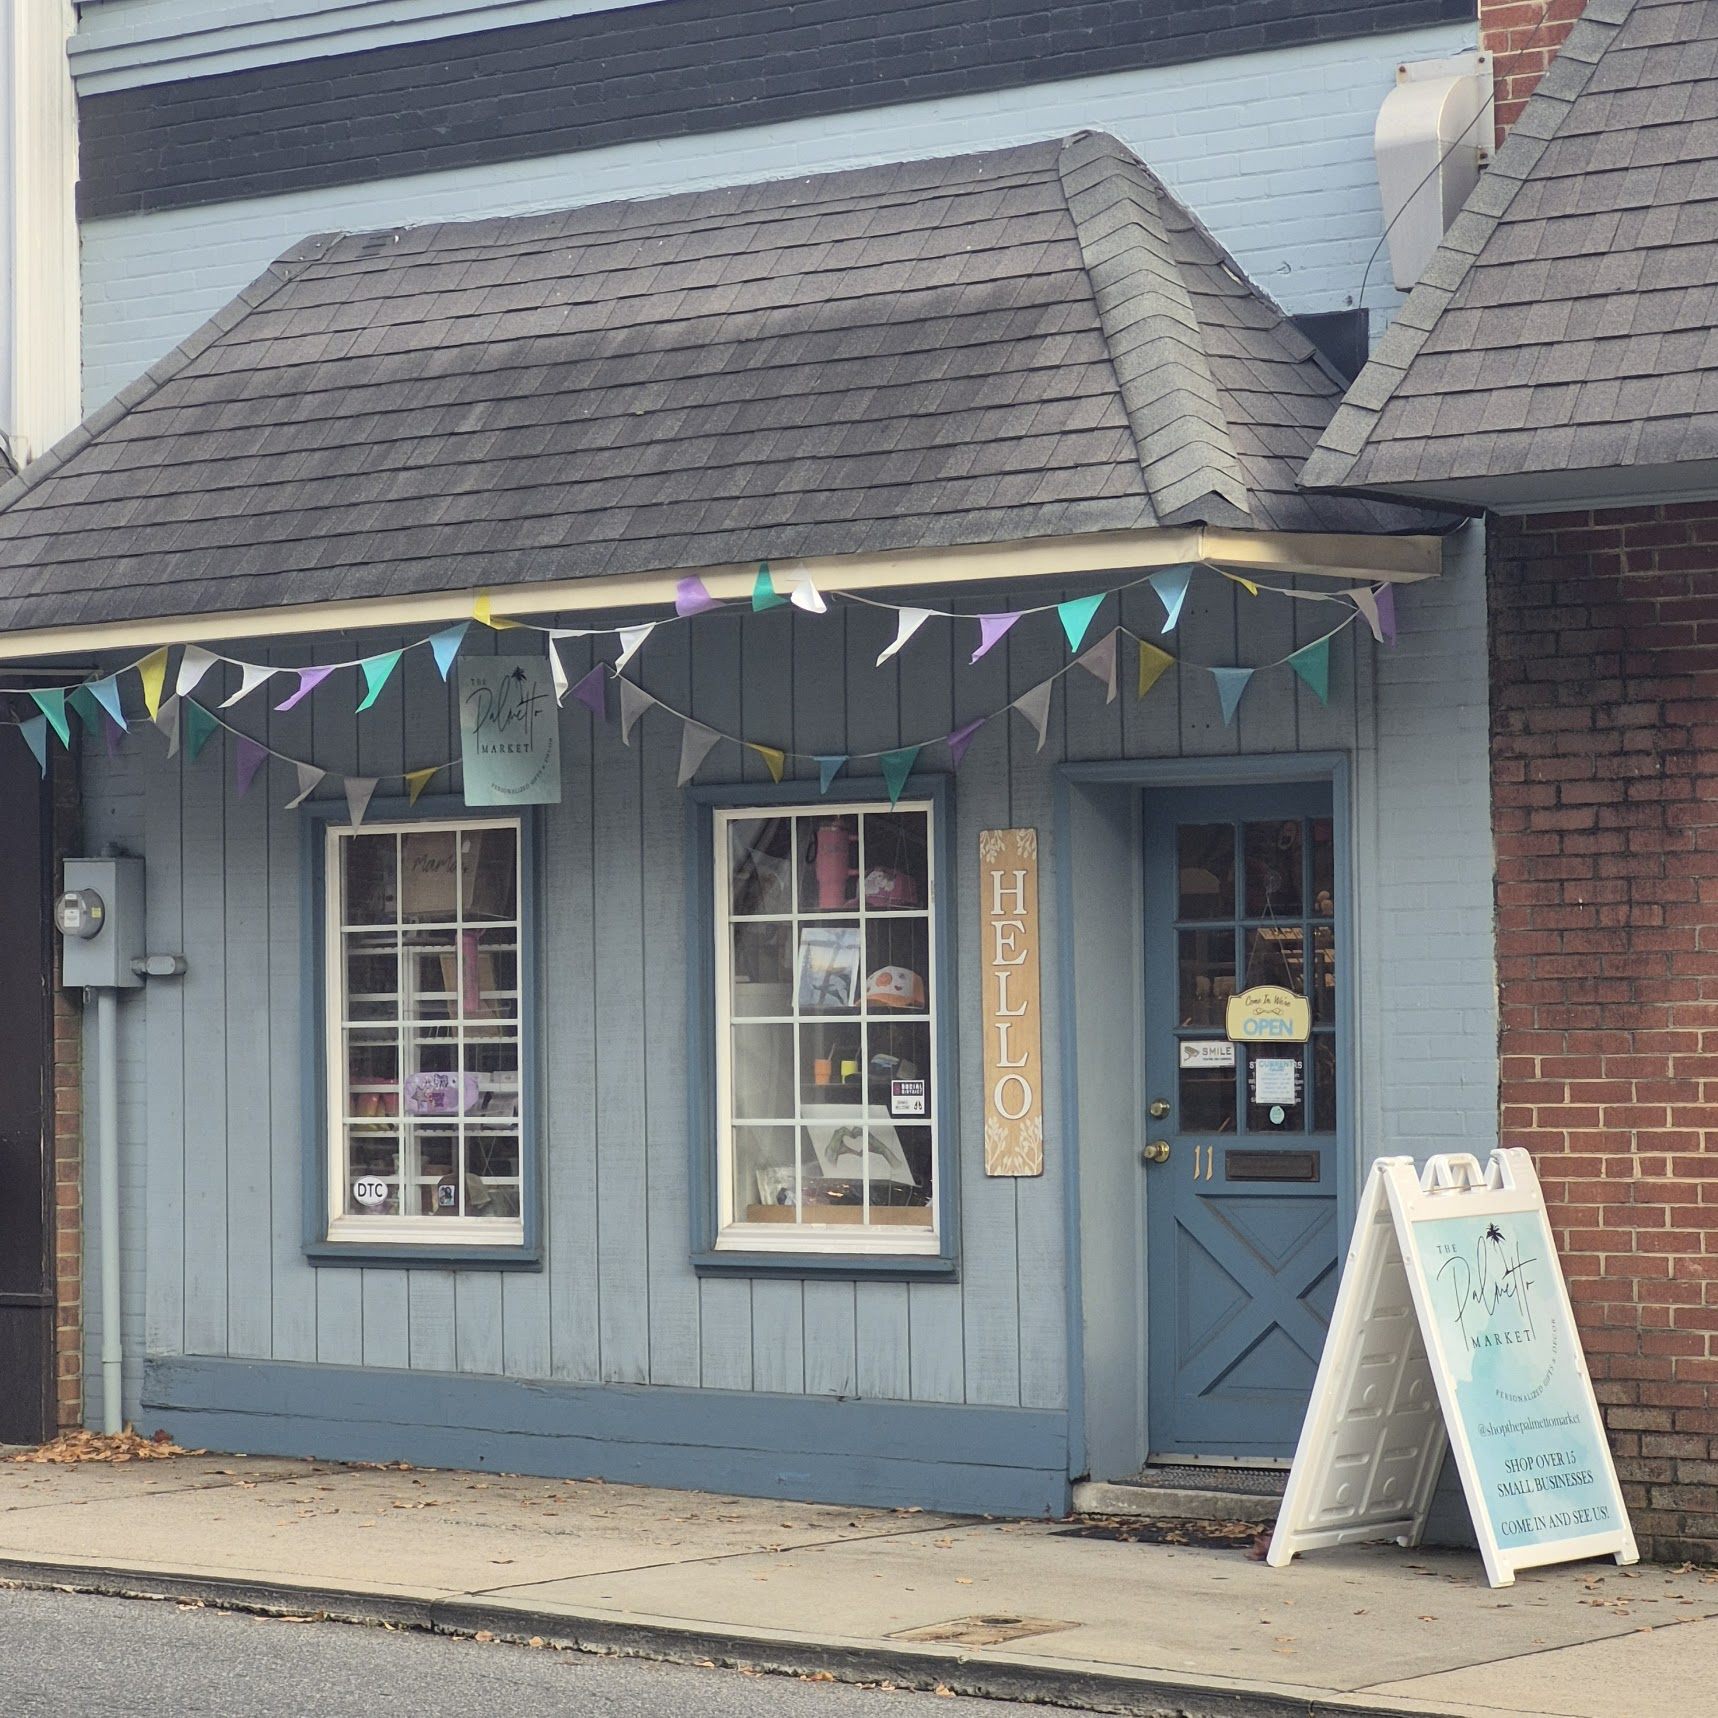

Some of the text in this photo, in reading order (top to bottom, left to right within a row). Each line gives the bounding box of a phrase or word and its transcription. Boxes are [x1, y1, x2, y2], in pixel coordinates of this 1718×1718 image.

[470, 678, 487, 687] THE
[481, 743, 530, 754] MARKET
[990, 869, 1032, 1120] HELLO
[1244, 1018, 1294, 1036] OPEN
[1202, 1046, 1232, 1056] SMILE
[1193, 1145, 1213, 1181] 11
[357, 1182, 384, 1199] DTC
[1435, 1243, 1458, 1254] THE
[1470, 1329, 1531, 1349] MARKET
[1495, 1385, 1544, 1402] PERSONALIZED
[1504, 1450, 1577, 1474] SHOP OVER 15
[1497, 1469, 1594, 1497] SMALL BUSINESSES
[1501, 1505, 1610, 1536] COME IN AND SEE US!
